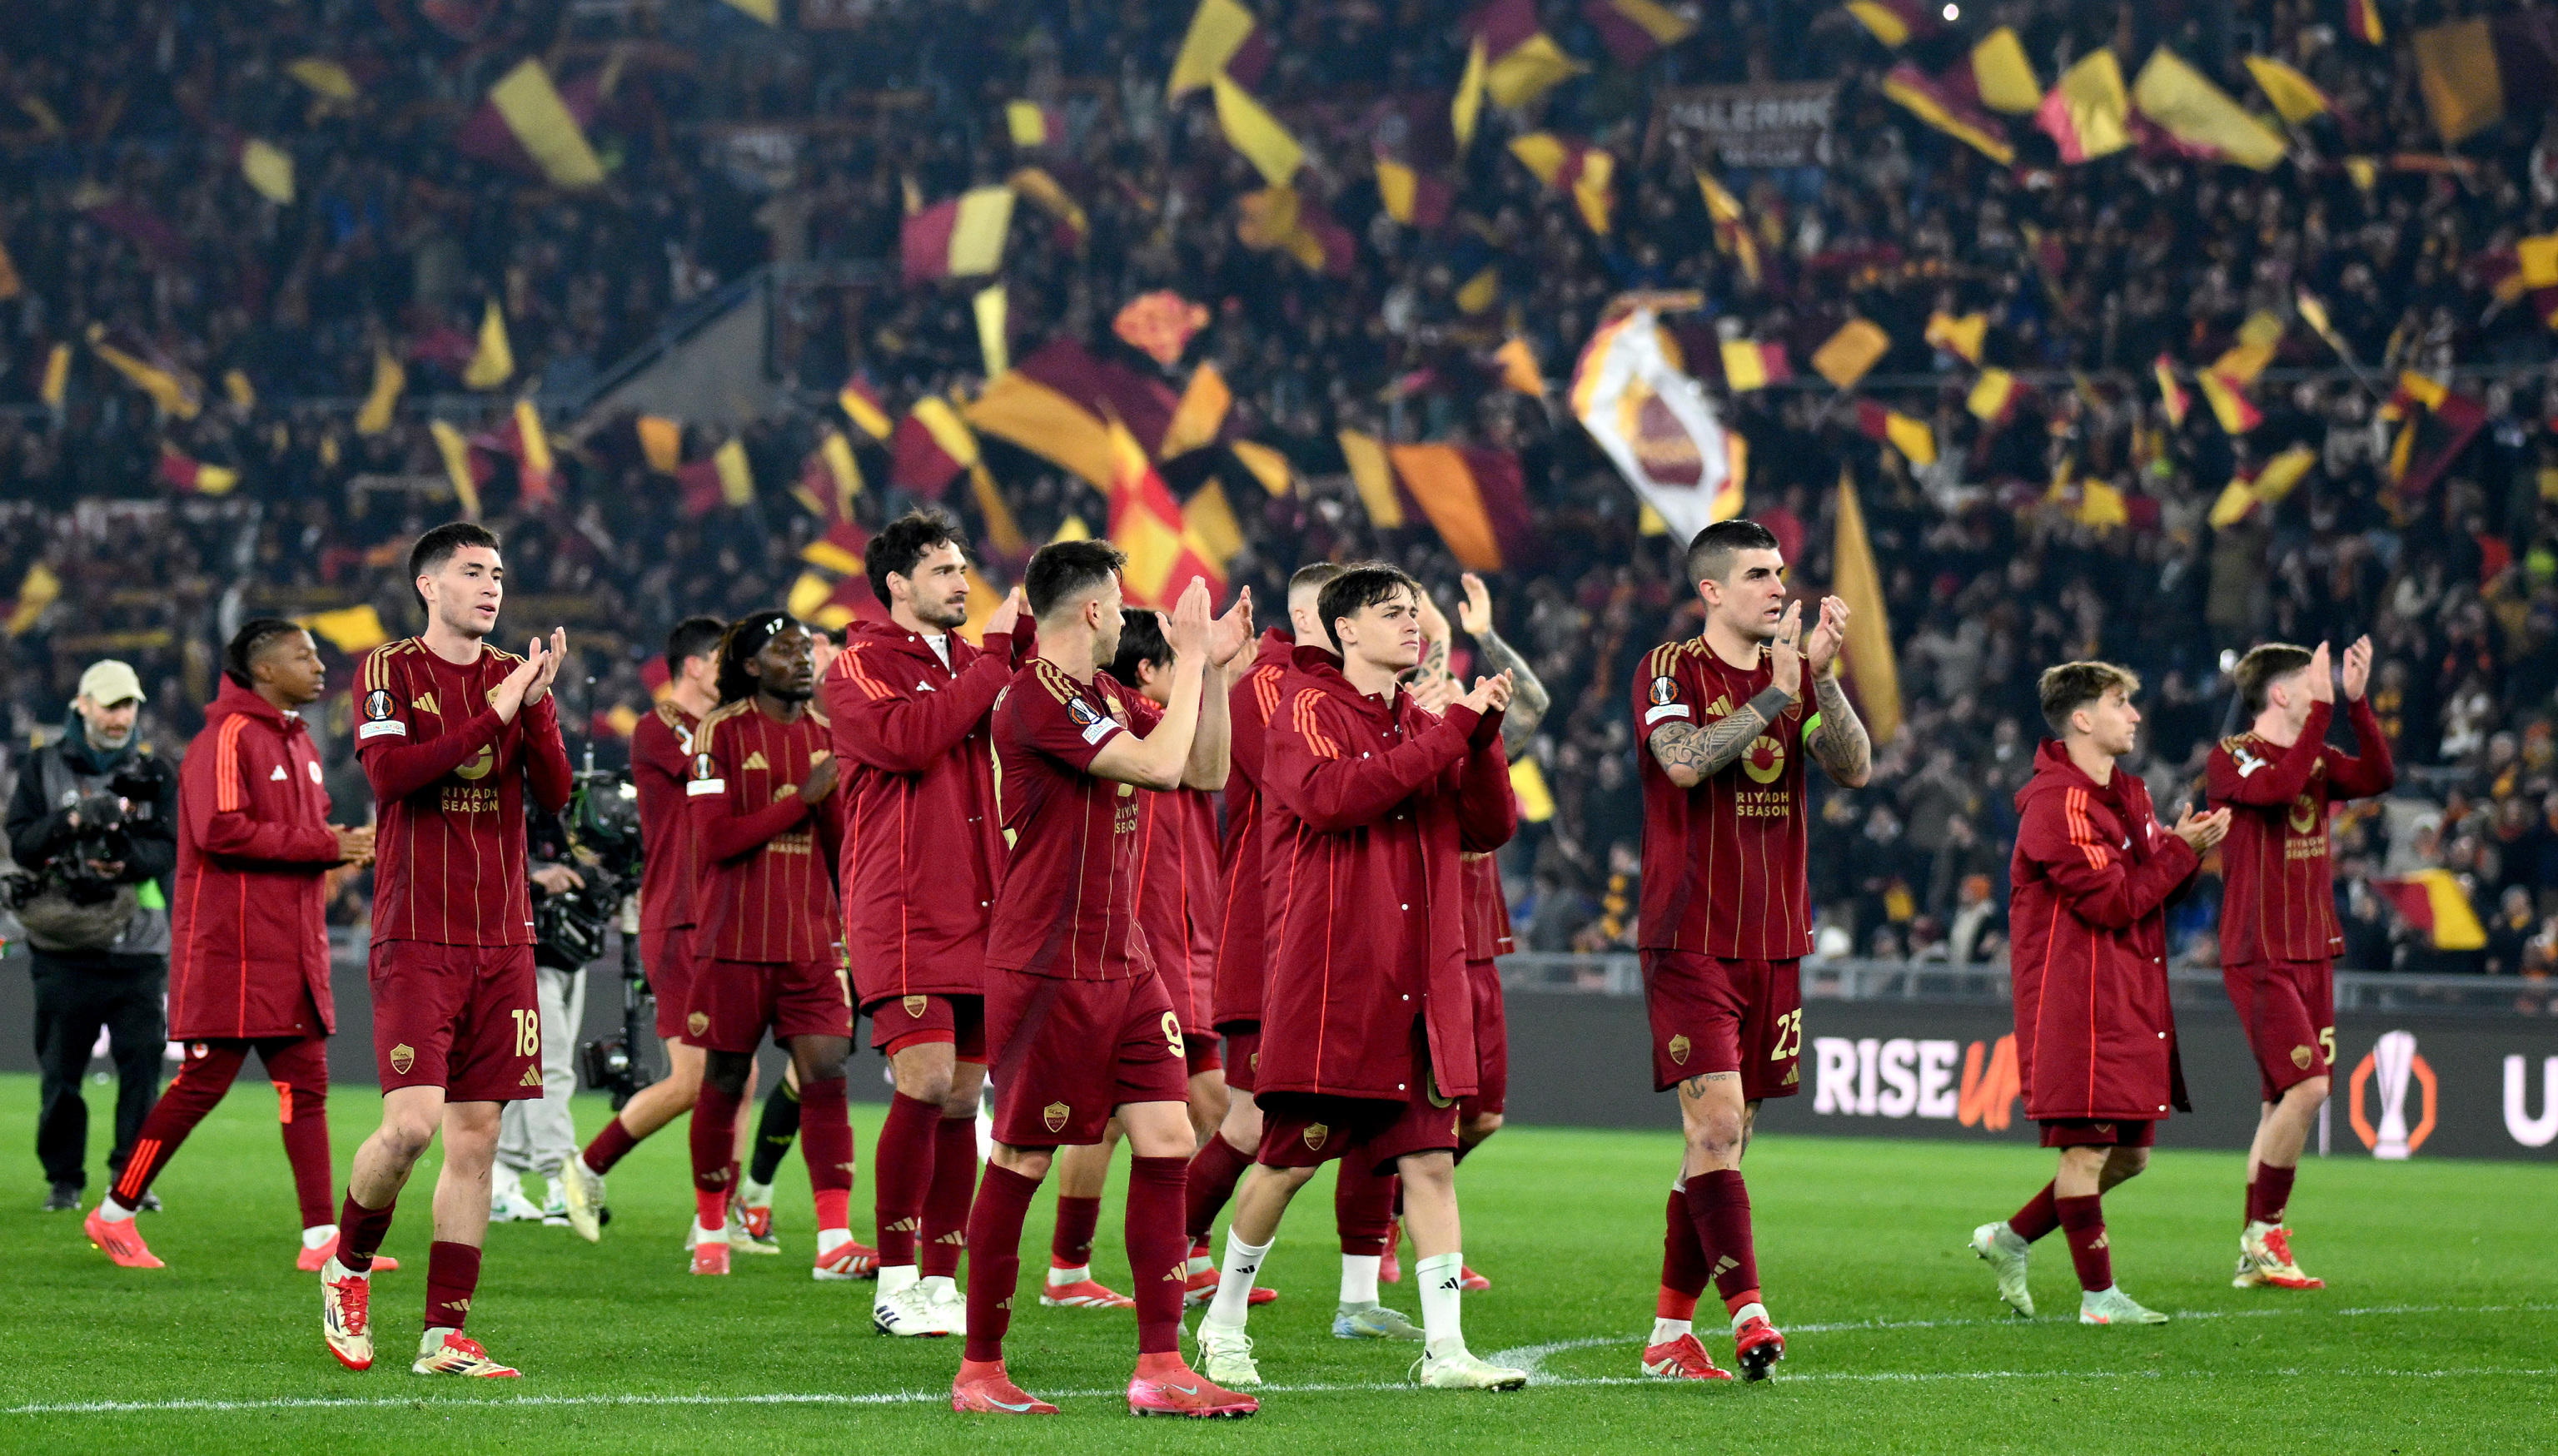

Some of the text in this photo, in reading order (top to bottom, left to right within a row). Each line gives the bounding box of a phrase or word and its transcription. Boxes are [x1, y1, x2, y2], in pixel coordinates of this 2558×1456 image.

[764, 617, 784, 635] 17
[442, 799, 499, 812] SEASON
[1736, 792, 1789, 803] RIYADH
[1737, 805, 1789, 817] SEASON
[511, 1008, 540, 1057] 18
[1161, 1011, 1185, 1058] 9
[1770, 1007, 1802, 1061] 23
[1813, 1037, 1958, 1118] RISE
